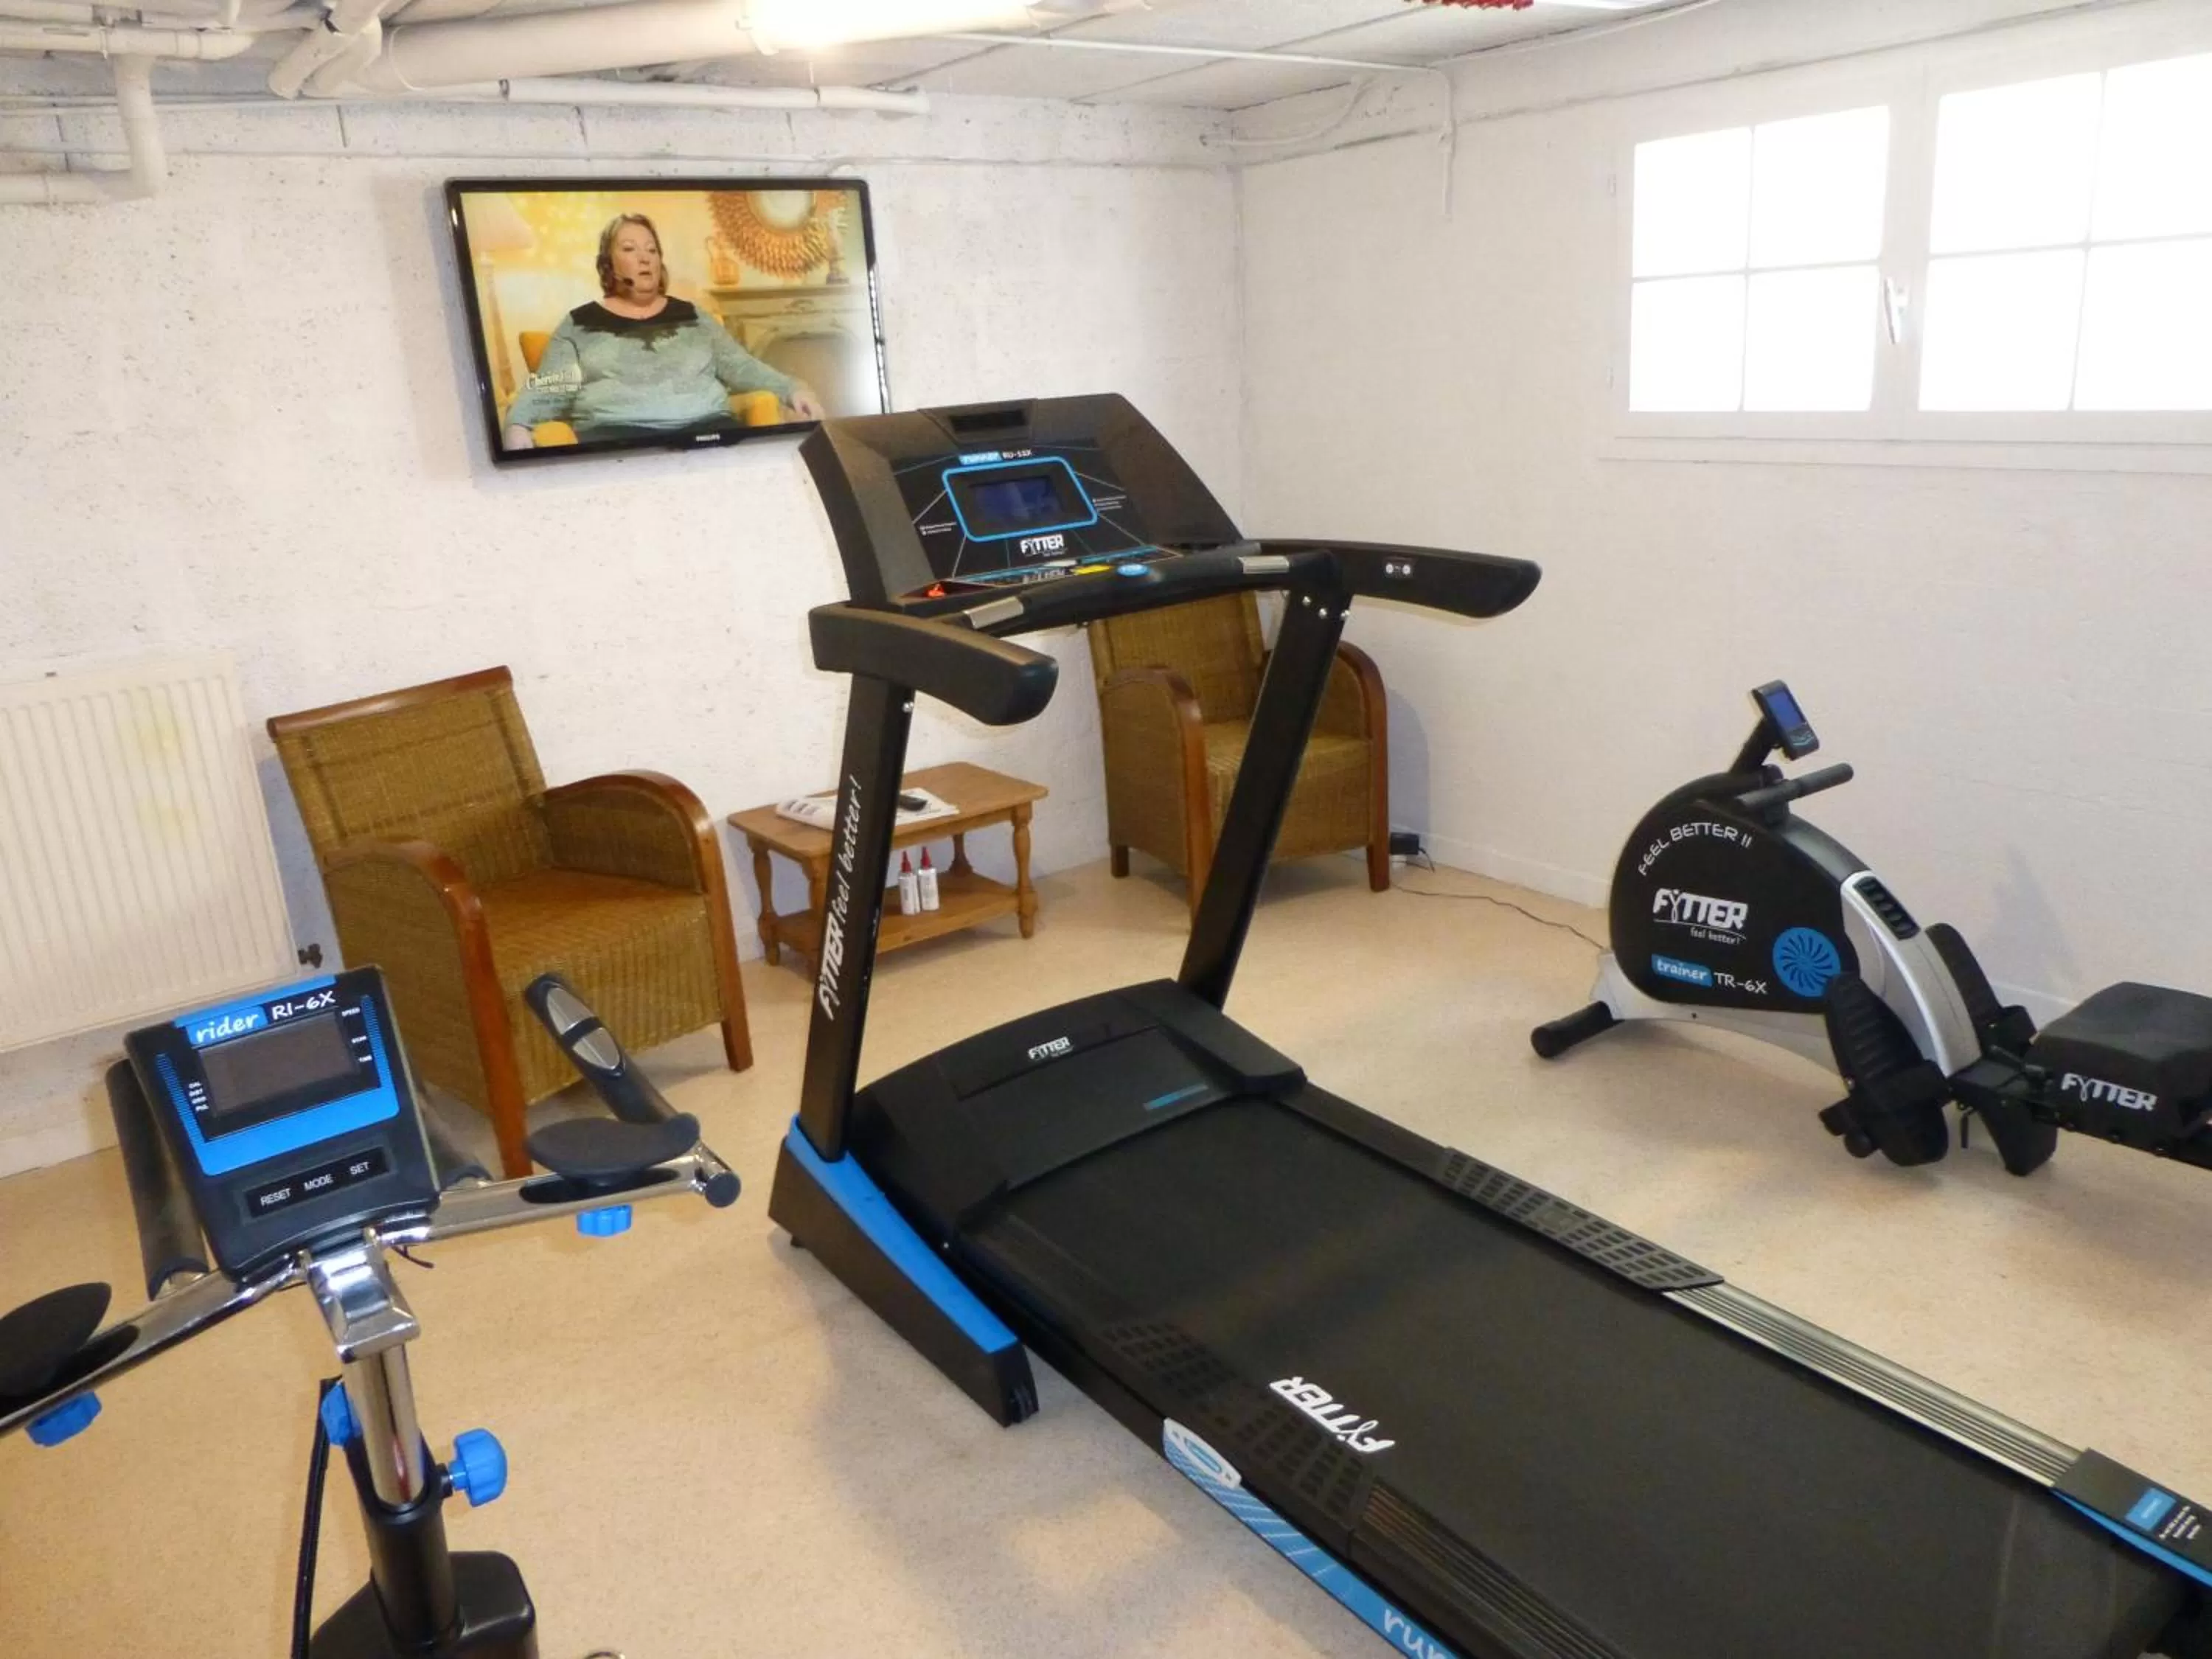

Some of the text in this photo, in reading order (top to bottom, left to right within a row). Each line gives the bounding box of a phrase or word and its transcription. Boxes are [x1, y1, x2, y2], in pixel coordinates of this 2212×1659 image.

[1020, 534, 1064, 555] FYTTER
[1638, 838, 1670, 877] FEEL
[1670, 822, 1738, 842] BETTER
[1652, 888, 1748, 930] FYTTER
[1657, 959, 1768, 995] trainer TR-6X
[196, 990, 336, 1043] rider RI-6X
[2061, 1073, 2158, 1111] FYTTER
[303, 1173, 333, 1191] MODE
[349, 1161, 369, 1175] SET
[260, 1188, 291, 1207] RESET
[1269, 1376, 1396, 1452] FYTTER
